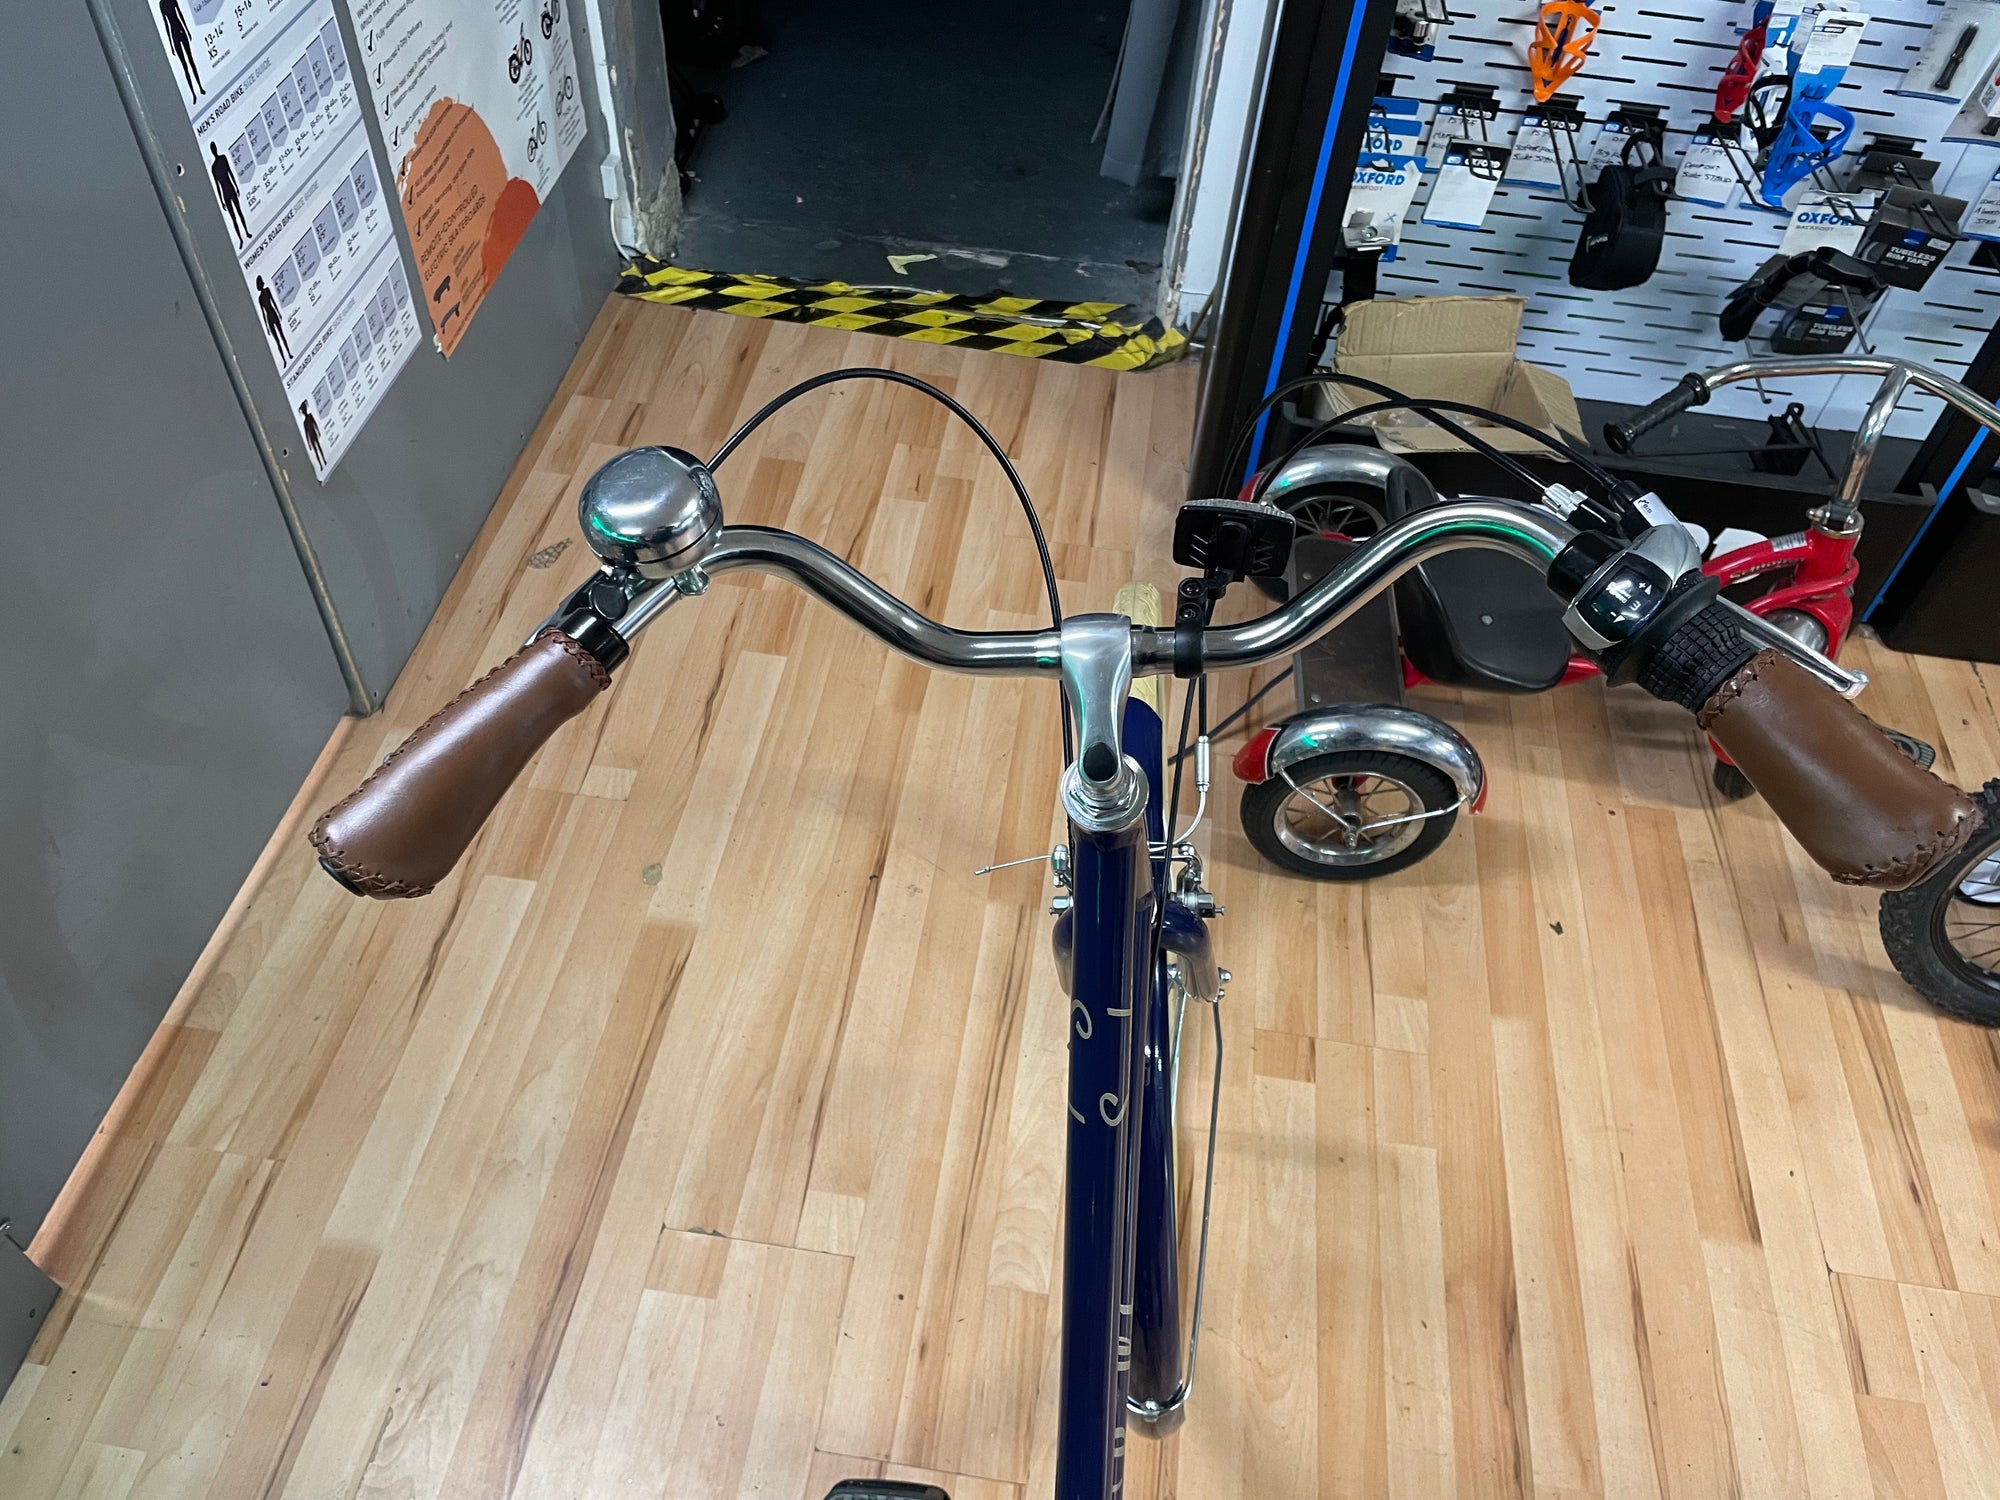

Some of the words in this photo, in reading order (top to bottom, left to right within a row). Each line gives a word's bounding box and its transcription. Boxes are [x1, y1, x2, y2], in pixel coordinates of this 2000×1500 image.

[236, 19, 243, 32] S
[207, 44, 218, 61] XS
[196, 112, 216, 137] MEN'S
[214, 96, 231, 119] ROAD
[229, 83, 244, 103] BIKE
[242, 71, 256, 91] SIZE
[254, 55, 271, 78] GUIDE
[419, 182, 478, 267] REMOTE-CONTROLLED
[243, 238, 268, 271] WOMEN'S
[267, 222, 282, 243] ROAD
[281, 208, 294, 227] BIKE
[423, 241, 449, 283] ELECTRIC
[448, 192, 486, 246] SKATEBOARDS
[1885, 251, 1906, 261] RIM
[1906, 256, 1931, 267] TAPE
[1890, 246, 1937, 262] TUBELESS
[1813, 322, 1854, 333] TUBELESS
[1827, 330, 1849, 338] TAPE
[286, 353, 312, 390] STANDARD
[311, 339, 322, 357] KIDS
[321, 325, 333, 343] BIKE
